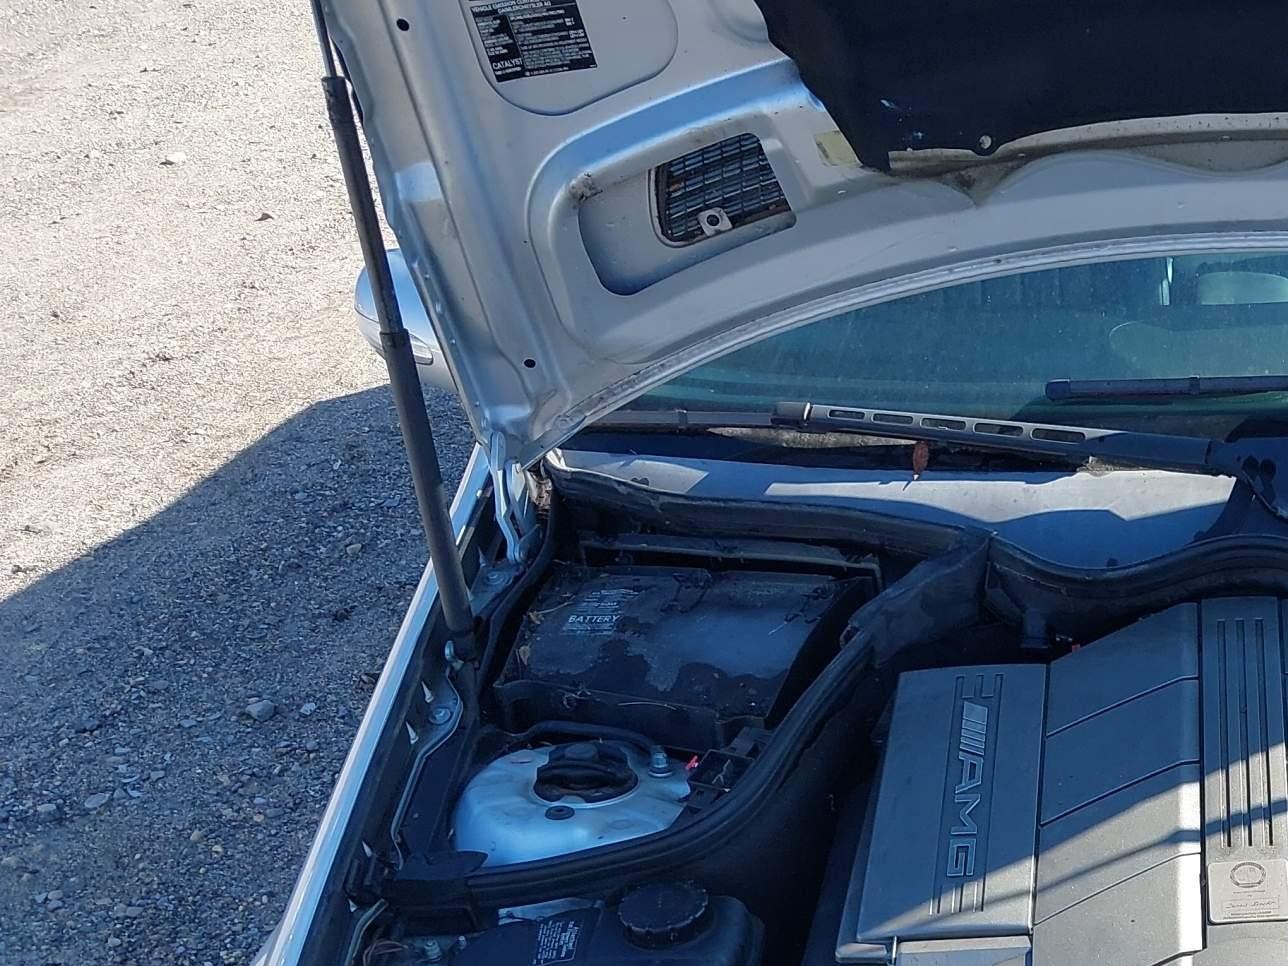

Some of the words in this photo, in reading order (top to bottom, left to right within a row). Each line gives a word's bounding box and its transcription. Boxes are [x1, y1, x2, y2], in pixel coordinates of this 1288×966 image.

[492, 57, 523, 70] CATALYST
[568, 615, 621, 623] BATTERY
[946, 750, 984, 879] AMG
